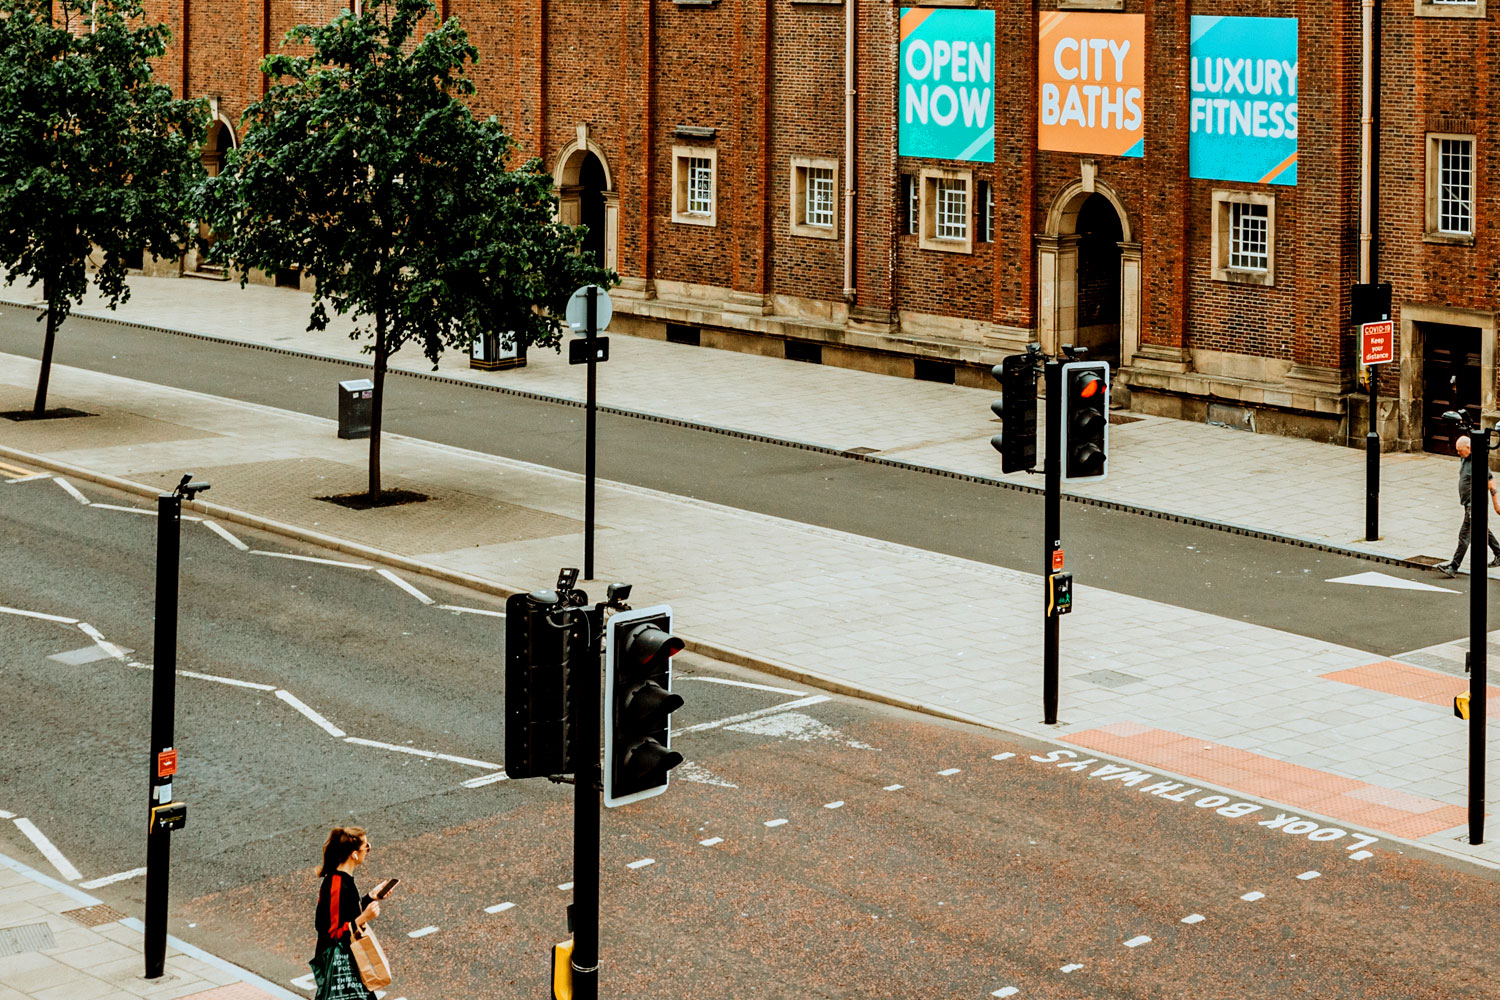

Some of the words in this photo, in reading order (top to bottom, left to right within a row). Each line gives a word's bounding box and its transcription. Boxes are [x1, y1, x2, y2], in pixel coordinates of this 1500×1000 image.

[905, 39, 991, 83] OPEN
[1053, 37, 1130, 82] CITY
[1191, 56, 1298, 96] LUXURY
[905, 84, 991, 128] NOW
[1041, 83, 1142, 131] BATHS
[1191, 100, 1298, 139] FITNESS
[1365, 325, 1391, 334] COVID-19
[1030, 749, 1153, 787] WAYS
[1140, 780, 1263, 818] BOTH
[1258, 813, 1379, 851] LOOK
